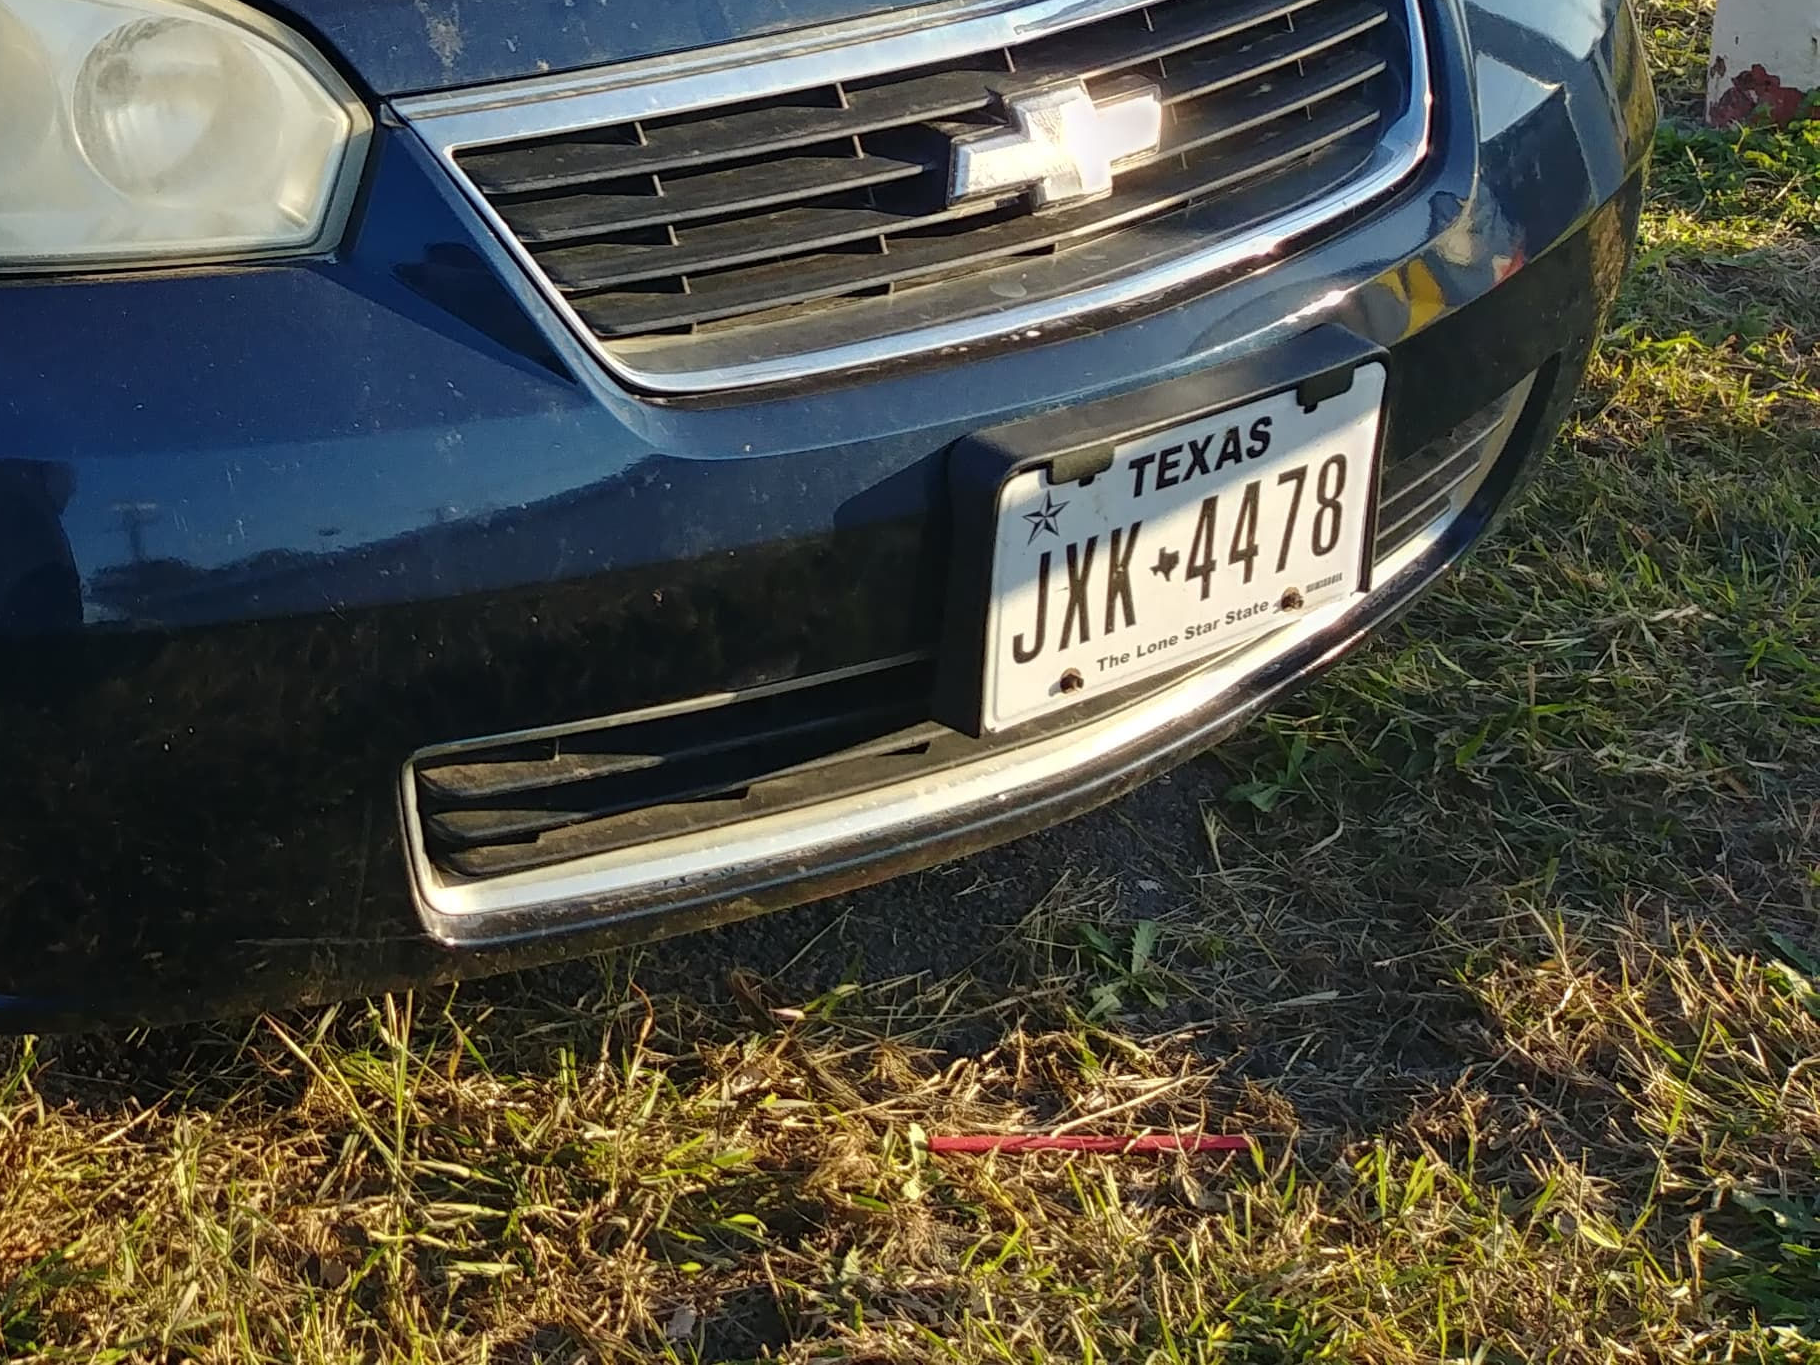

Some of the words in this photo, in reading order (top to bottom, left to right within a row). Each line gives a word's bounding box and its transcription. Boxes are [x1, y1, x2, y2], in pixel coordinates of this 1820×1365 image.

[1128, 416, 1272, 498] TEXAS
[1012, 521, 1142, 665] JXK
[1185, 453, 1348, 601] 4478
[1096, 651, 1130, 673] The
[1136, 636, 1178, 659] Lone
[1184, 619, 1221, 642] Star
[1225, 600, 1269, 625] State
